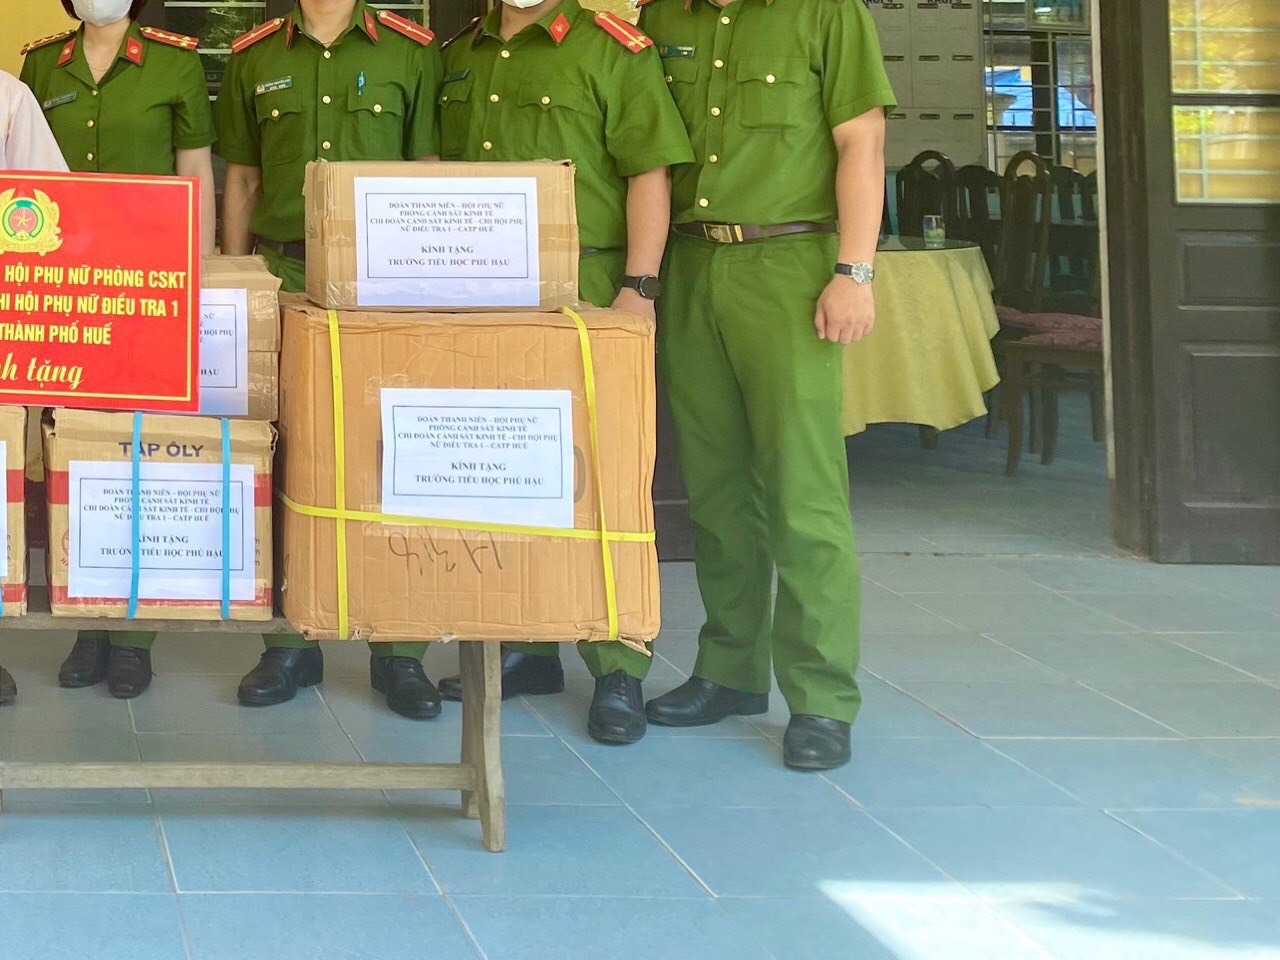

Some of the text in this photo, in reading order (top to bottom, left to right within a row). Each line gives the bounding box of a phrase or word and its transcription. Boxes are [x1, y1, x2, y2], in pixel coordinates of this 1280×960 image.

[4, 262, 30, 286] HỘI
[33, 265, 64, 288] PHỤ
[68, 264, 90, 285] NỮ
[93, 265, 144, 288] PHÒNG
[148, 270, 187, 289] CSKT
[14, 290, 39, 315] HỘI
[43, 294, 73, 317] PHỤ
[77, 293, 100, 314] NỮ
[101, 292, 136, 316] ĐIỀU
[139, 298, 167, 317] TRA
[171, 300, 179, 317] 1
[49, 320, 79, 344] PHỐ
[83, 322, 113, 345] HUẾ
[26, 357, 84, 390] tặng
